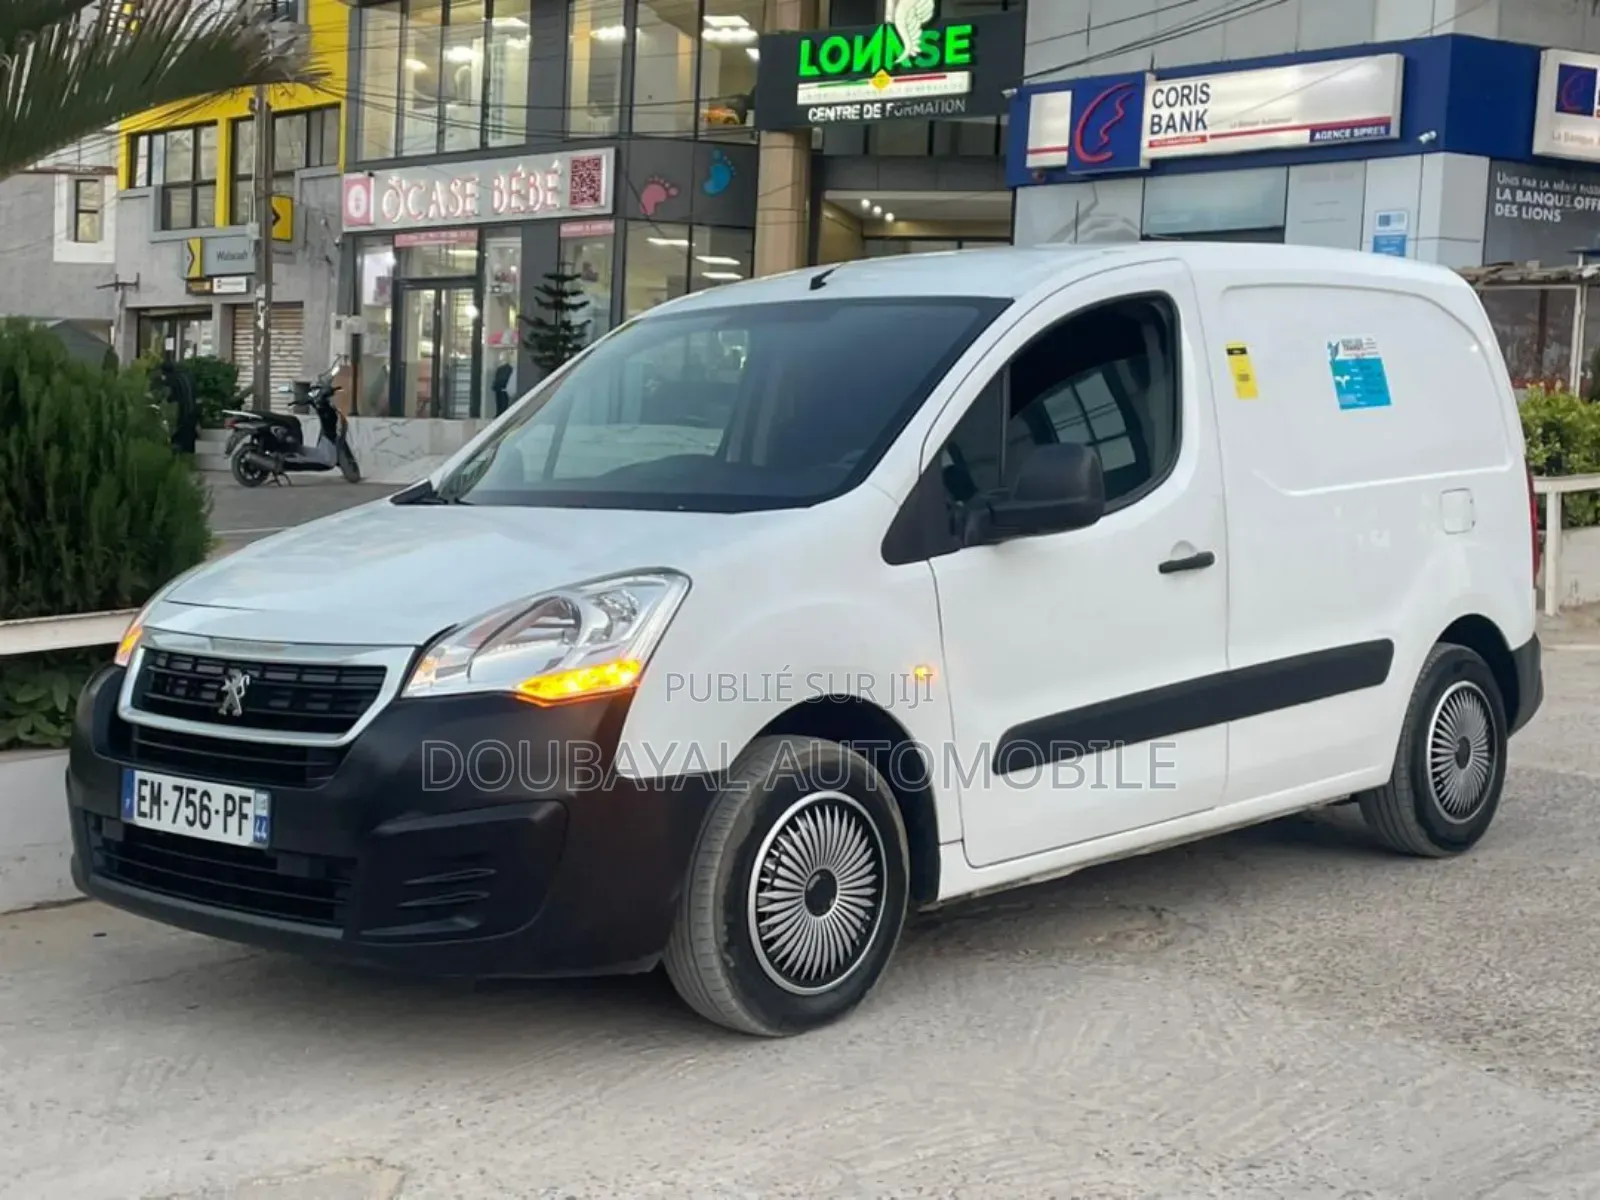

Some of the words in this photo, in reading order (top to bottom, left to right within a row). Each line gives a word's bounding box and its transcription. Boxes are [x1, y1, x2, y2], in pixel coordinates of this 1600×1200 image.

[1152, 82, 1211, 110] CORIS
[808, 104, 861, 122] CENTRE
[863, 103, 882, 119] DE
[885, 99, 967, 118] FORMATION
[1150, 108, 1209, 136] BANK
[1314, 127, 1352, 141] AGENCE
[492, 158, 562, 213] BÉBÉ
[1496, 188, 1512, 201] LA
[1495, 203, 1518, 217] DES
[1522, 206, 1561, 222] LIONS
